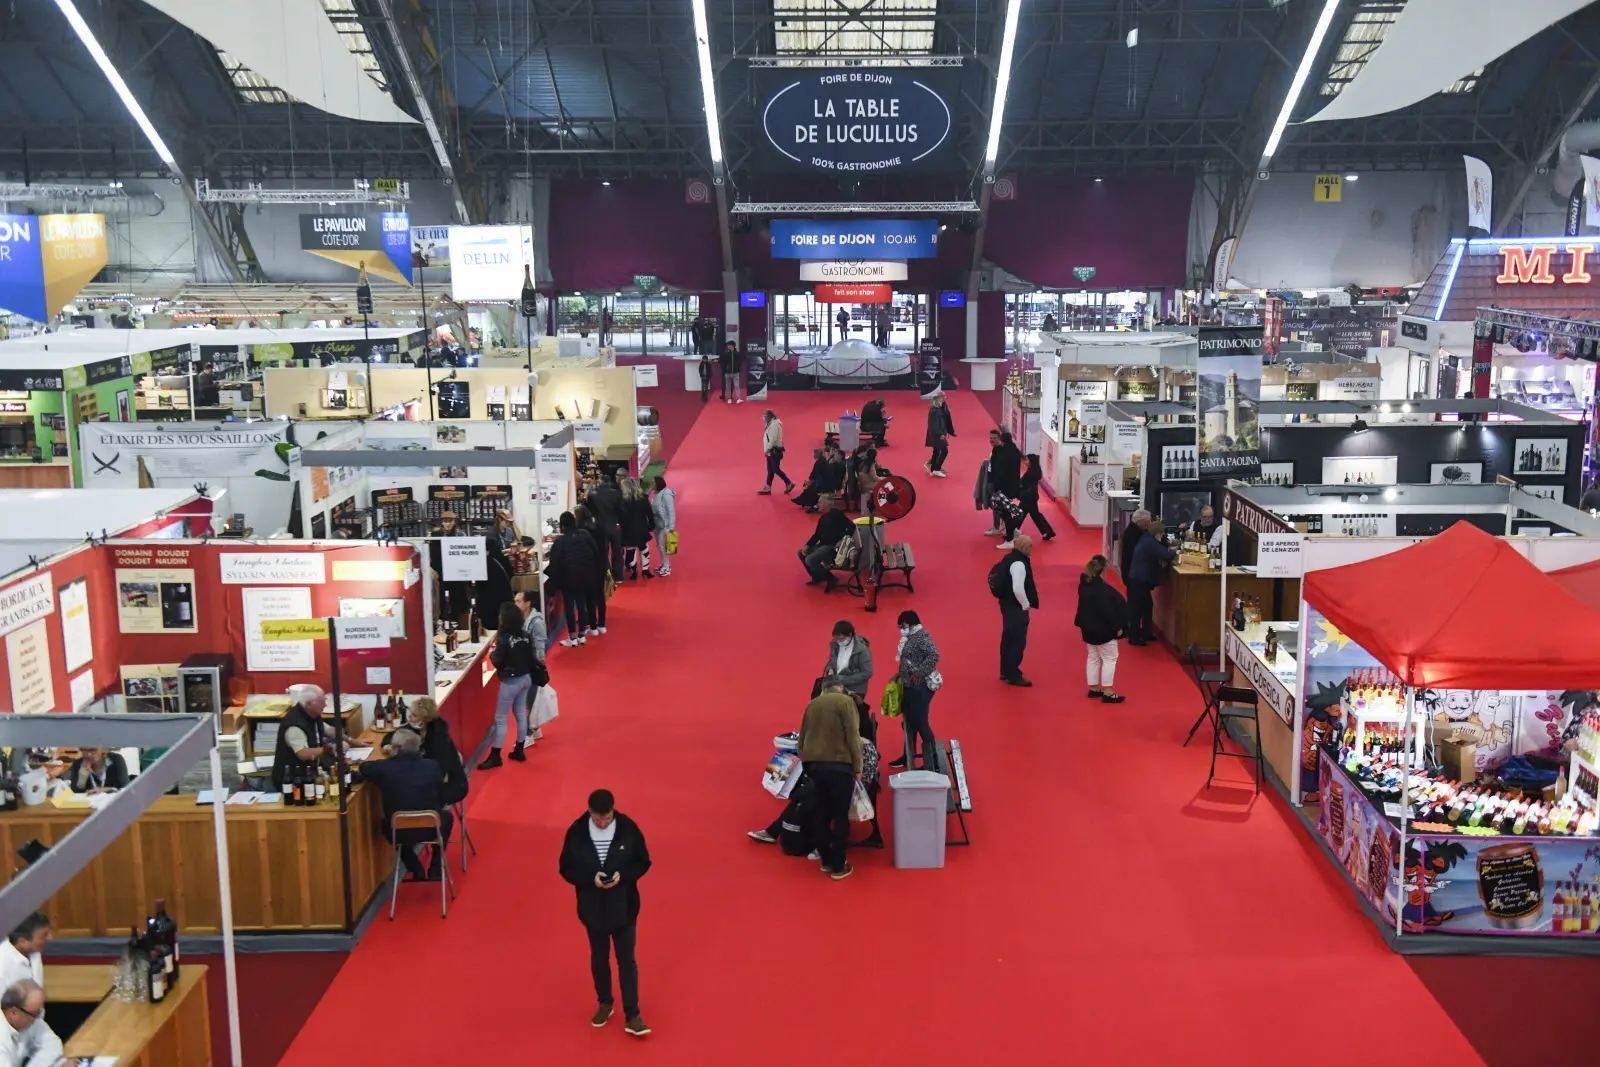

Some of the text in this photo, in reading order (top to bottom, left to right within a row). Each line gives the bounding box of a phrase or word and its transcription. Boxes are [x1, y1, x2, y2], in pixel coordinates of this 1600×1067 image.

[820, 74, 892, 85] FOIRE DE DIJON
[814, 99, 900, 117] LA TABLE
[795, 124, 918, 143] DE LUCULLUS
[811, 156, 902, 171] 100% GASTRONOMIE
[1318, 176, 1339, 185] HALL
[1325, 185, 1330, 199] 1
[313, 218, 366, 232] LE PAVILLON
[322, 232, 360, 246] CÔTE-D'OR
[791, 234, 916, 245] FOIRE DE DIJON 100 ANS
[463, 253, 510, 265] DELIN
[821, 264, 885, 276] GASTRONOMIE
[1200, 339, 1262, 350] PATRIMONIO
[100, 433, 281, 445] ELIXIR DES MOUSSAILLONS
[1200, 456, 1259, 467] SANTA PAOLINA
[1236, 500, 1286, 533] PATRIMONI
[0, 582, 45, 611] BORDEAUX
[1234, 639, 1281, 710] VILLA CORSICA
